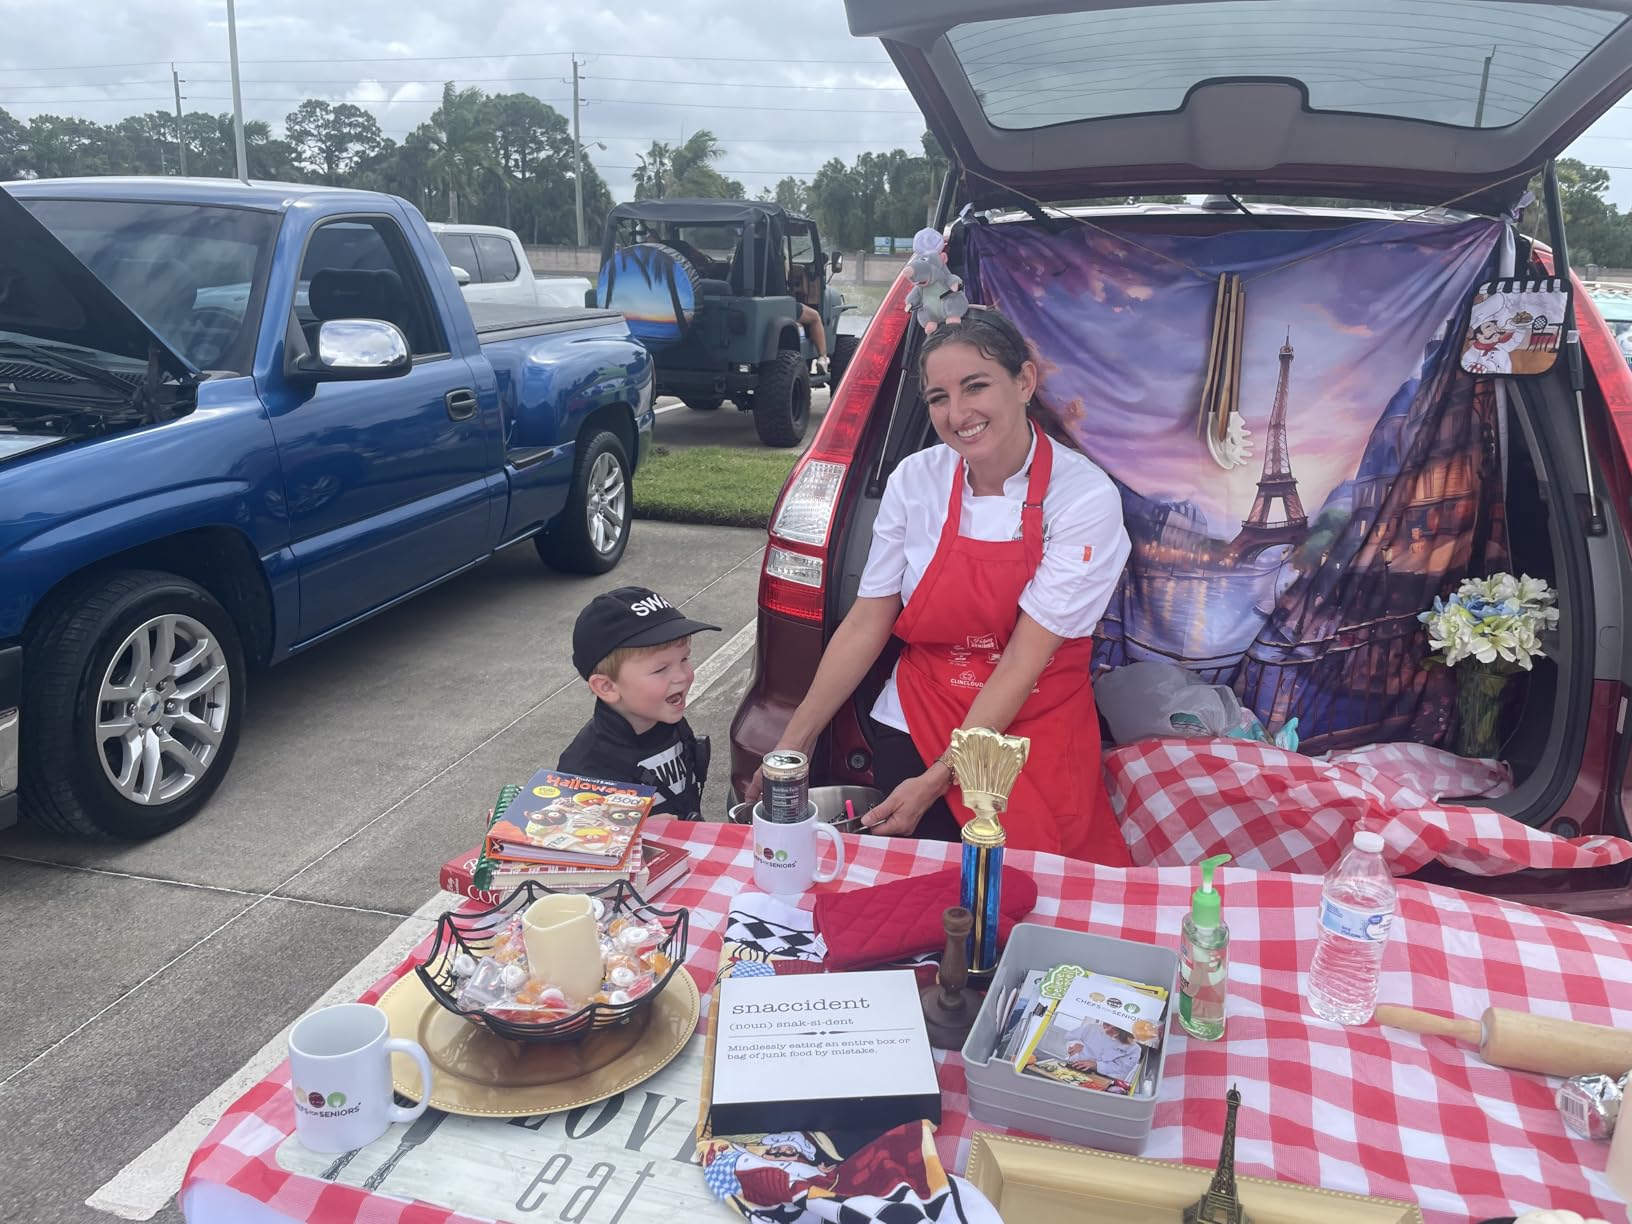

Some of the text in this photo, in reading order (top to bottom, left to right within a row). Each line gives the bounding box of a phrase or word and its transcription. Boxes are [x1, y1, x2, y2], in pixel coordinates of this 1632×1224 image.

[631, 593, 673, 617] SWA
[950, 678, 984, 688] CLINCLOUD
[732, 997, 870, 1015] snaccident
[1075, 997, 1101, 1010] CHEFS
[729, 1018, 854, 1031] (noun) snak-si-dent
[728, 1043, 786, 1051] Mindlessly
[789, 1041, 823, 1049] eating
[727, 1052, 747, 1060] bag
[761, 1051, 787, 1059] junk
[815, 1049, 828, 1057] by
[319, 1106, 360, 1118] SENIORS
[515, 1153, 656, 1224] eat
